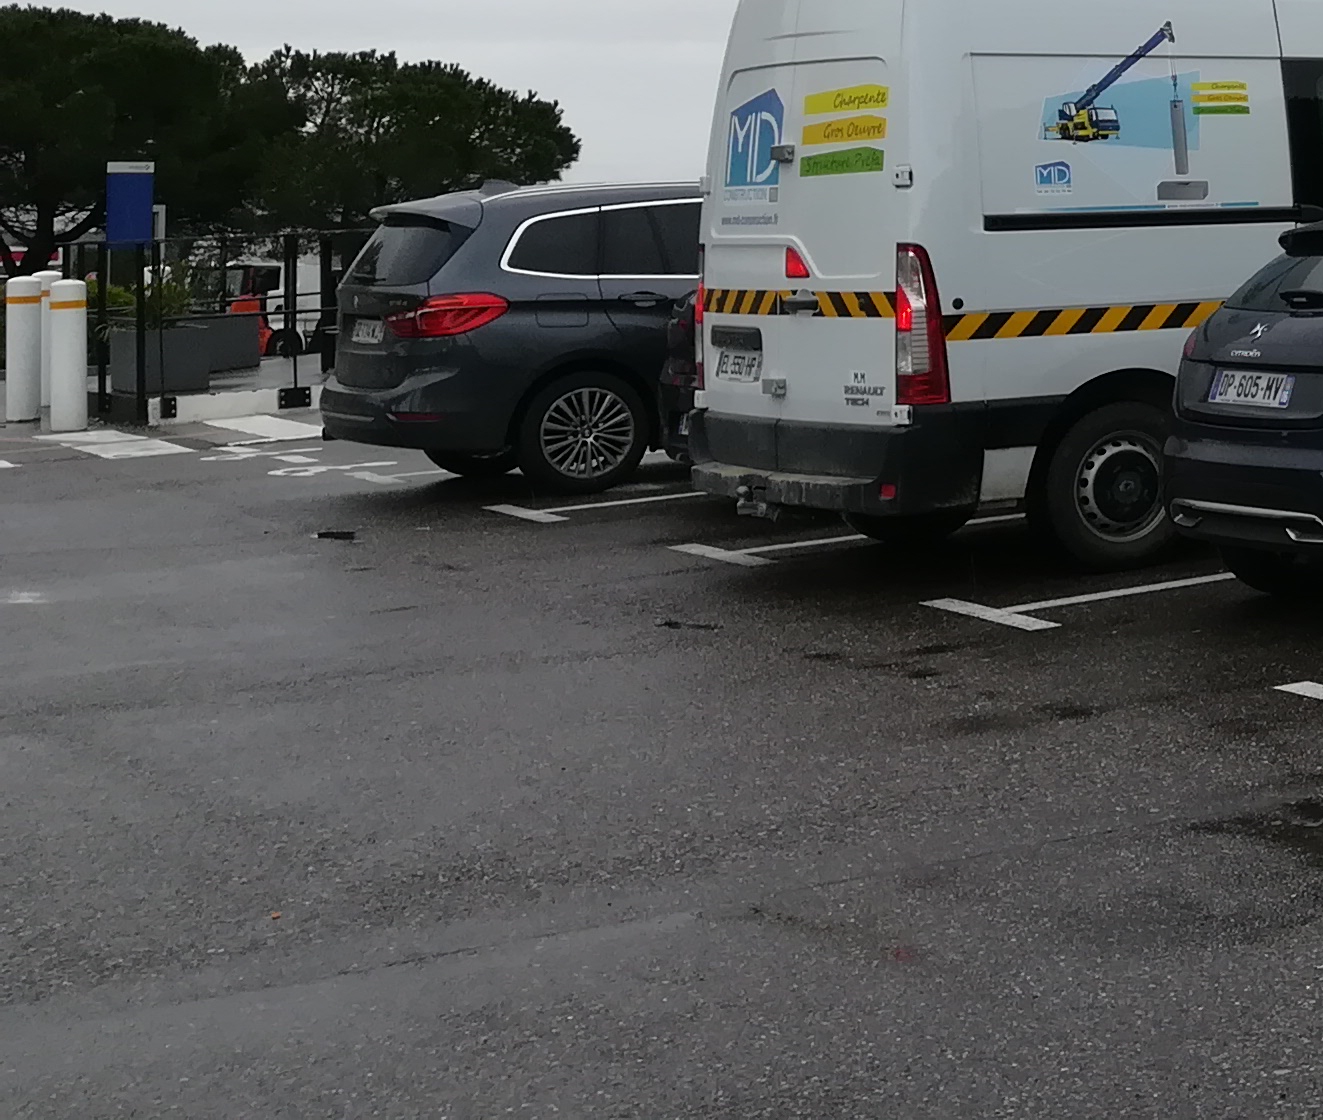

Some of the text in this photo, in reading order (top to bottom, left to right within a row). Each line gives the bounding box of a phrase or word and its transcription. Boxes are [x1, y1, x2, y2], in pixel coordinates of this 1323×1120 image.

[833, 90, 886, 109] Charpente
[823, 123, 844, 139] Gros
[726, 111, 779, 185] MD
[1036, 165, 1070, 185] MD
[843, 385, 886, 396] RENAULT
